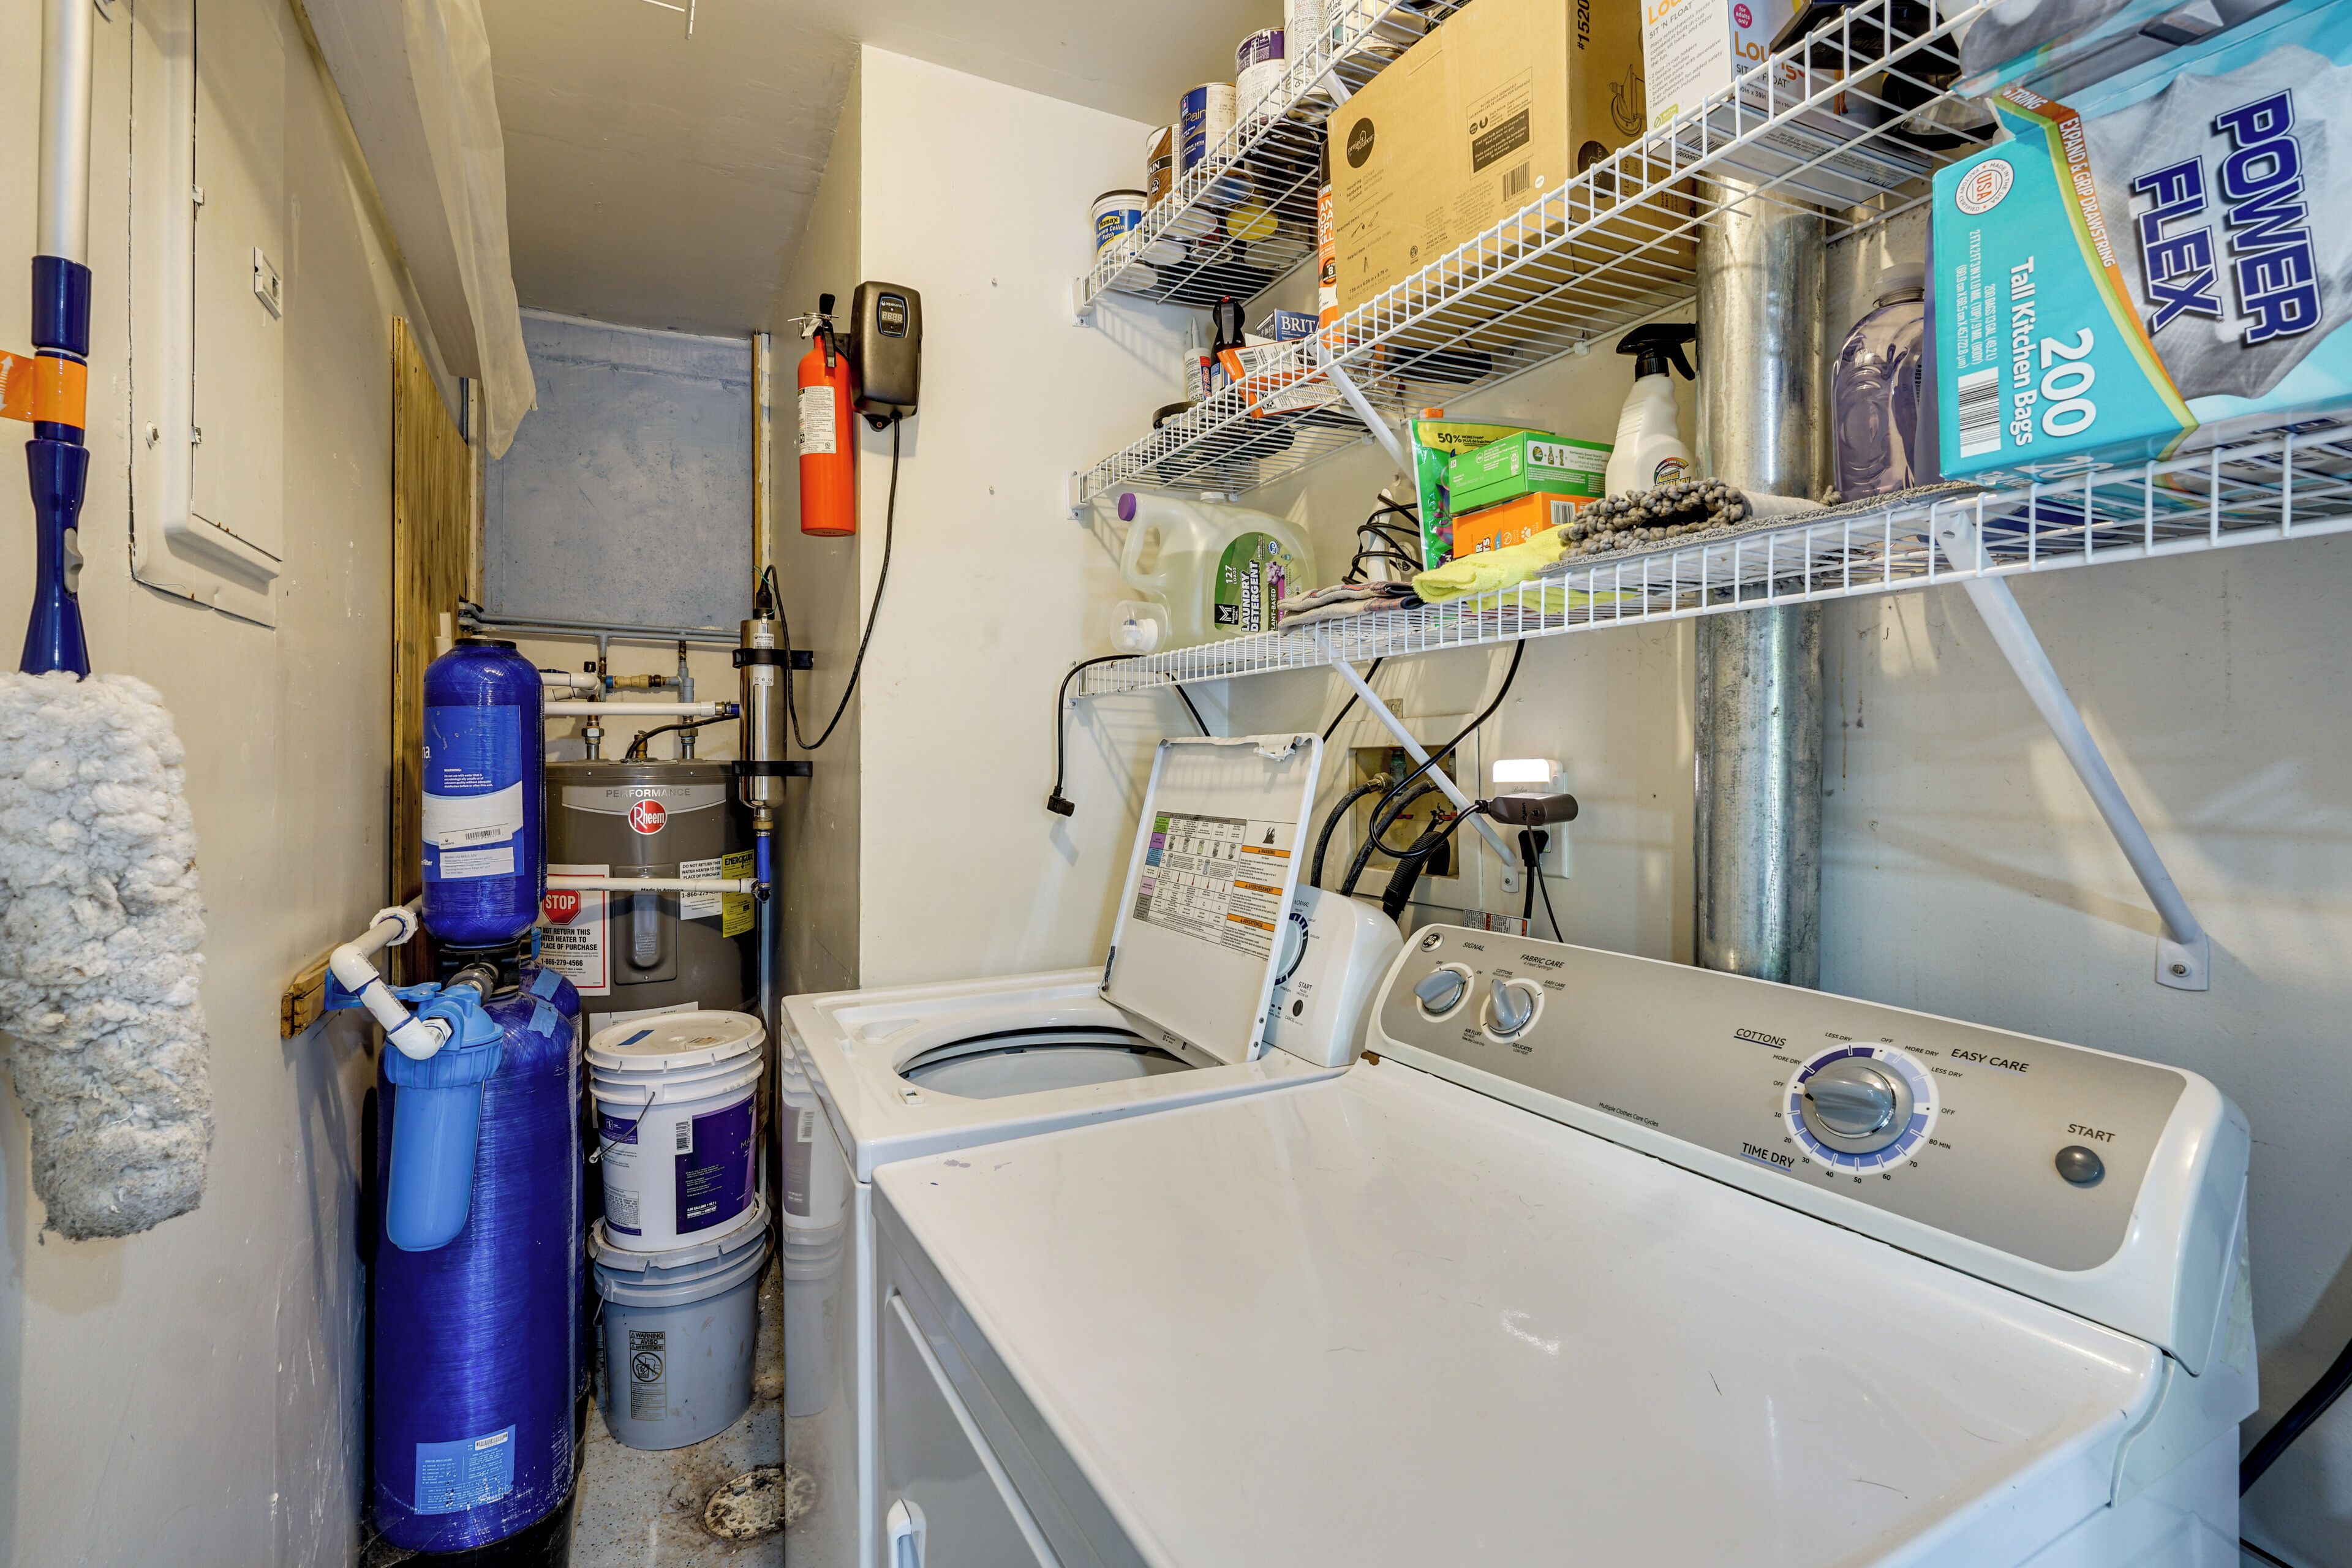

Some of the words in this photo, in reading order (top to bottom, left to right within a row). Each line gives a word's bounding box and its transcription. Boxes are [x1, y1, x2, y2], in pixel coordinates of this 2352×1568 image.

[1735, 11, 1751, 20] adults
[1649, 26, 1660, 38] SIT
[1651, 34, 1676, 55] convenient
[1676, 20, 1694, 35] built-in
[1695, 12, 1705, 23] cup
[1651, 48, 1667, 61] holder,
[1674, 32, 1687, 44] back,
[1688, 24, 1698, 34] and
[1699, 13, 1713, 26] enjoy
[1652, 80, 1664, 89] Clear
[1673, 64, 1684, 77] panel
[1686, 57, 1695, 66] with
[1697, 39, 1721, 59] decorative
[1655, 62, 1670, 75] built-in
[1671, 56, 1679, 66] cup
[1681, 43, 1697, 57] holders
[1708, 51, 1723, 63] safety
[1656, 69, 1672, 82] durable
[1672, 55, 1689, 69] handles
[1653, 97, 1667, 108] Repair
[1667, 87, 1679, 99] patch
[1681, 72, 1700, 88] included
[1348, 137, 1364, 155] project
[1357, 135, 1373, 151] source
[2059, 116, 2086, 164] EXPAND
[1990, 163, 2006, 172] MADE
[2071, 162, 2087, 174] &
[1977, 172, 1992, 202] USA
[2073, 172, 2095, 202] GRIP
[1959, 195, 1980, 211] CERTIFIED
[1098, 216, 1119, 228] Homax
[2215, 88, 2323, 344] POWER
[2079, 198, 2116, 268] DRAWSTRING
[2133, 155, 2223, 334] FLEX
[1328, 266, 1333, 275] 8
[2010, 255, 2035, 301] Tall
[2011, 300, 2037, 388] Kitchen
[2040, 327, 2097, 437] 200
[2010, 389, 2037, 447] Bags
[1438, 432, 1463, 443] 50%
[1225, 565, 1234, 584] 127
[1241, 570, 1250, 632] LAUNDRY
[1250, 559, 1261, 633] DETERGENT
[606, 788, 690, 797] PERFORMANCE
[634, 799, 665, 829] Rheem
[1248, 884, 1273, 893] AVERTISSEMENT
[545, 894, 576, 910] STOP
[1294, 899, 1310, 908] NORMAL
[1243, 919, 1264, 928] ADVERTENCIA
[1463, 941, 1485, 951] SIGNAL
[541, 958, 583, 967] 1-866-279-4566
[1520, 954, 1545, 965] FABRIC
[1545, 959, 1565, 968] CARE
[1298, 981, 1313, 991] START
[1736, 1028, 1787, 1046] COTTONS
[1825, 1031, 1839, 1040] LESS
[1512, 1042, 1532, 1052] DELICATES
[1904, 1045, 1923, 1054] MORE
[1951, 1048, 1988, 1064] EASY
[1989, 1057, 2030, 1073] CARE
[1599, 1102, 1616, 1112] Multiple
[1616, 1108, 1633, 1118] Clothes
[1633, 1114, 1644, 1122] Care
[1644, 1118, 1659, 1127] Cycles
[1941, 1107, 1956, 1116] OFF
[2067, 1123, 2116, 1143] START
[1743, 1142, 1768, 1159] TIME
[1771, 1152, 1795, 1168] DRY
[1939, 1141, 1951, 1150] MIN
